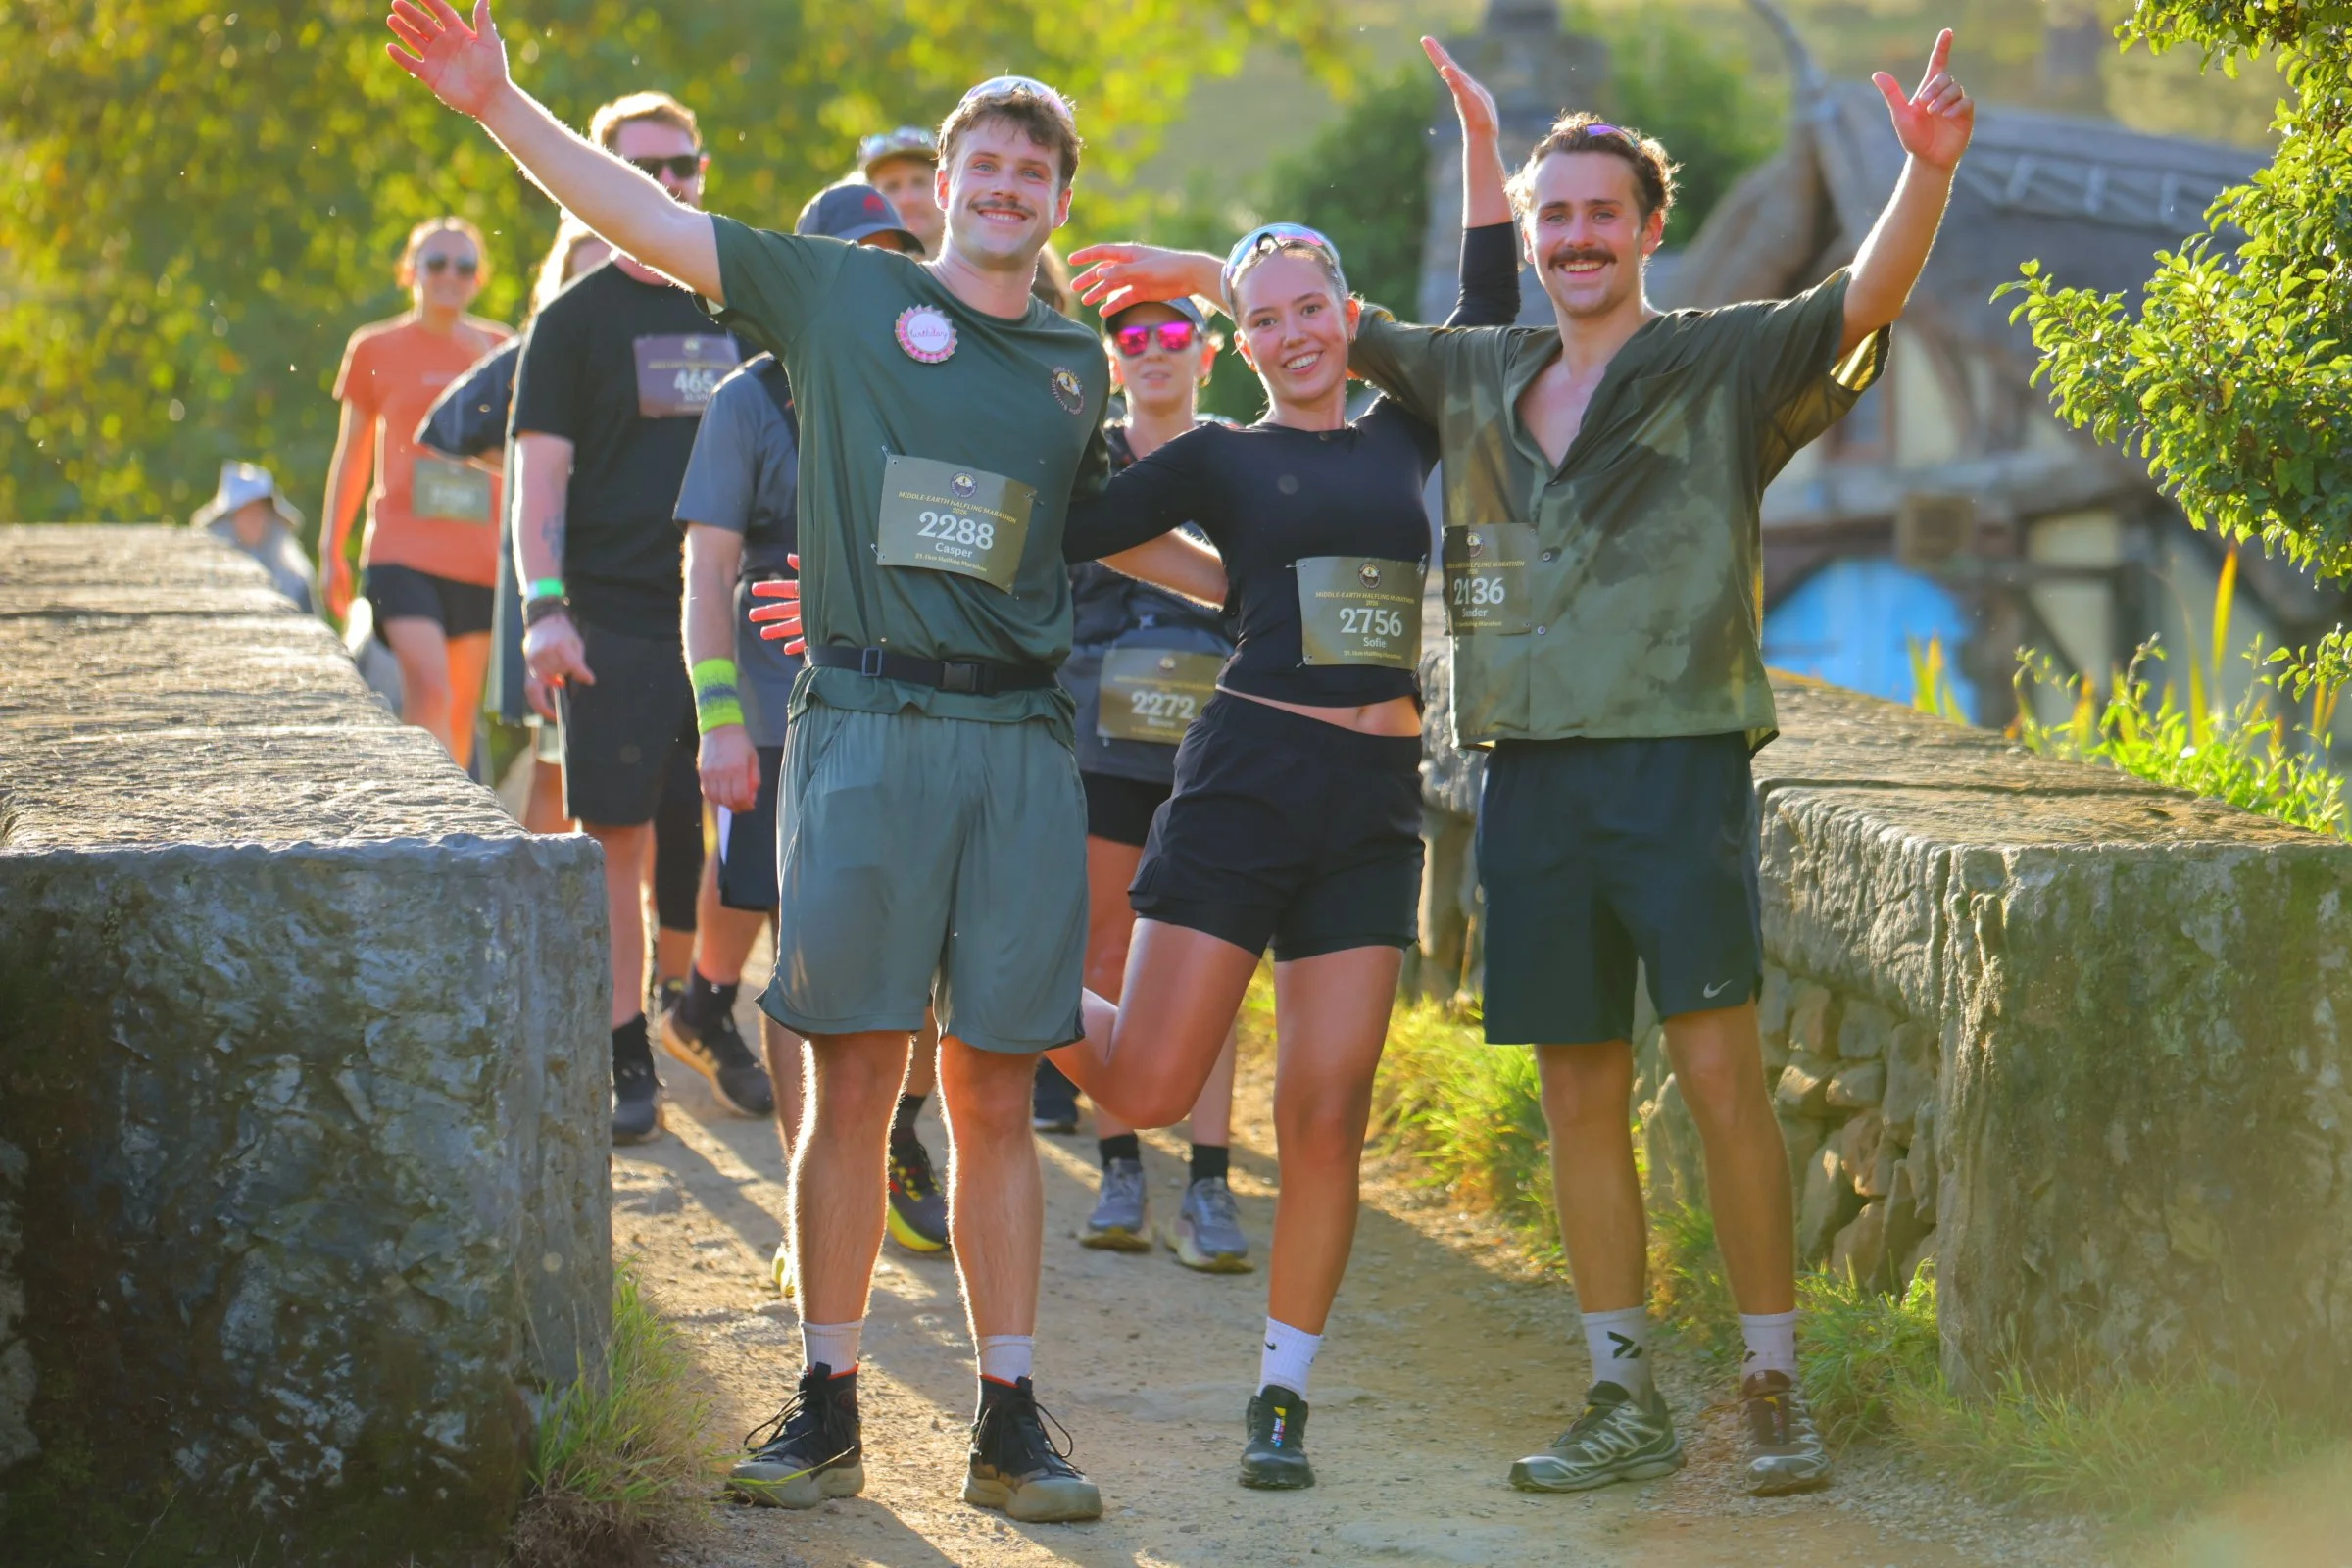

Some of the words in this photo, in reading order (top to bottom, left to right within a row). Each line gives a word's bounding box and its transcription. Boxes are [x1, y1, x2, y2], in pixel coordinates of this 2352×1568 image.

[898, 491, 949, 505] MIDDLE-EARTH
[950, 499, 983, 512] HALFLING
[983, 508, 1017, 525] MARATHON
[916, 511, 995, 550] 2288
[935, 542, 973, 559] Casper
[1361, 592, 1390, 601] HALFLING
[1453, 577, 1505, 605] 2136
[1339, 607, 1402, 637] 2756
[1363, 637, 1387, 649] Sofie
[1131, 690, 1195, 719] 2272
